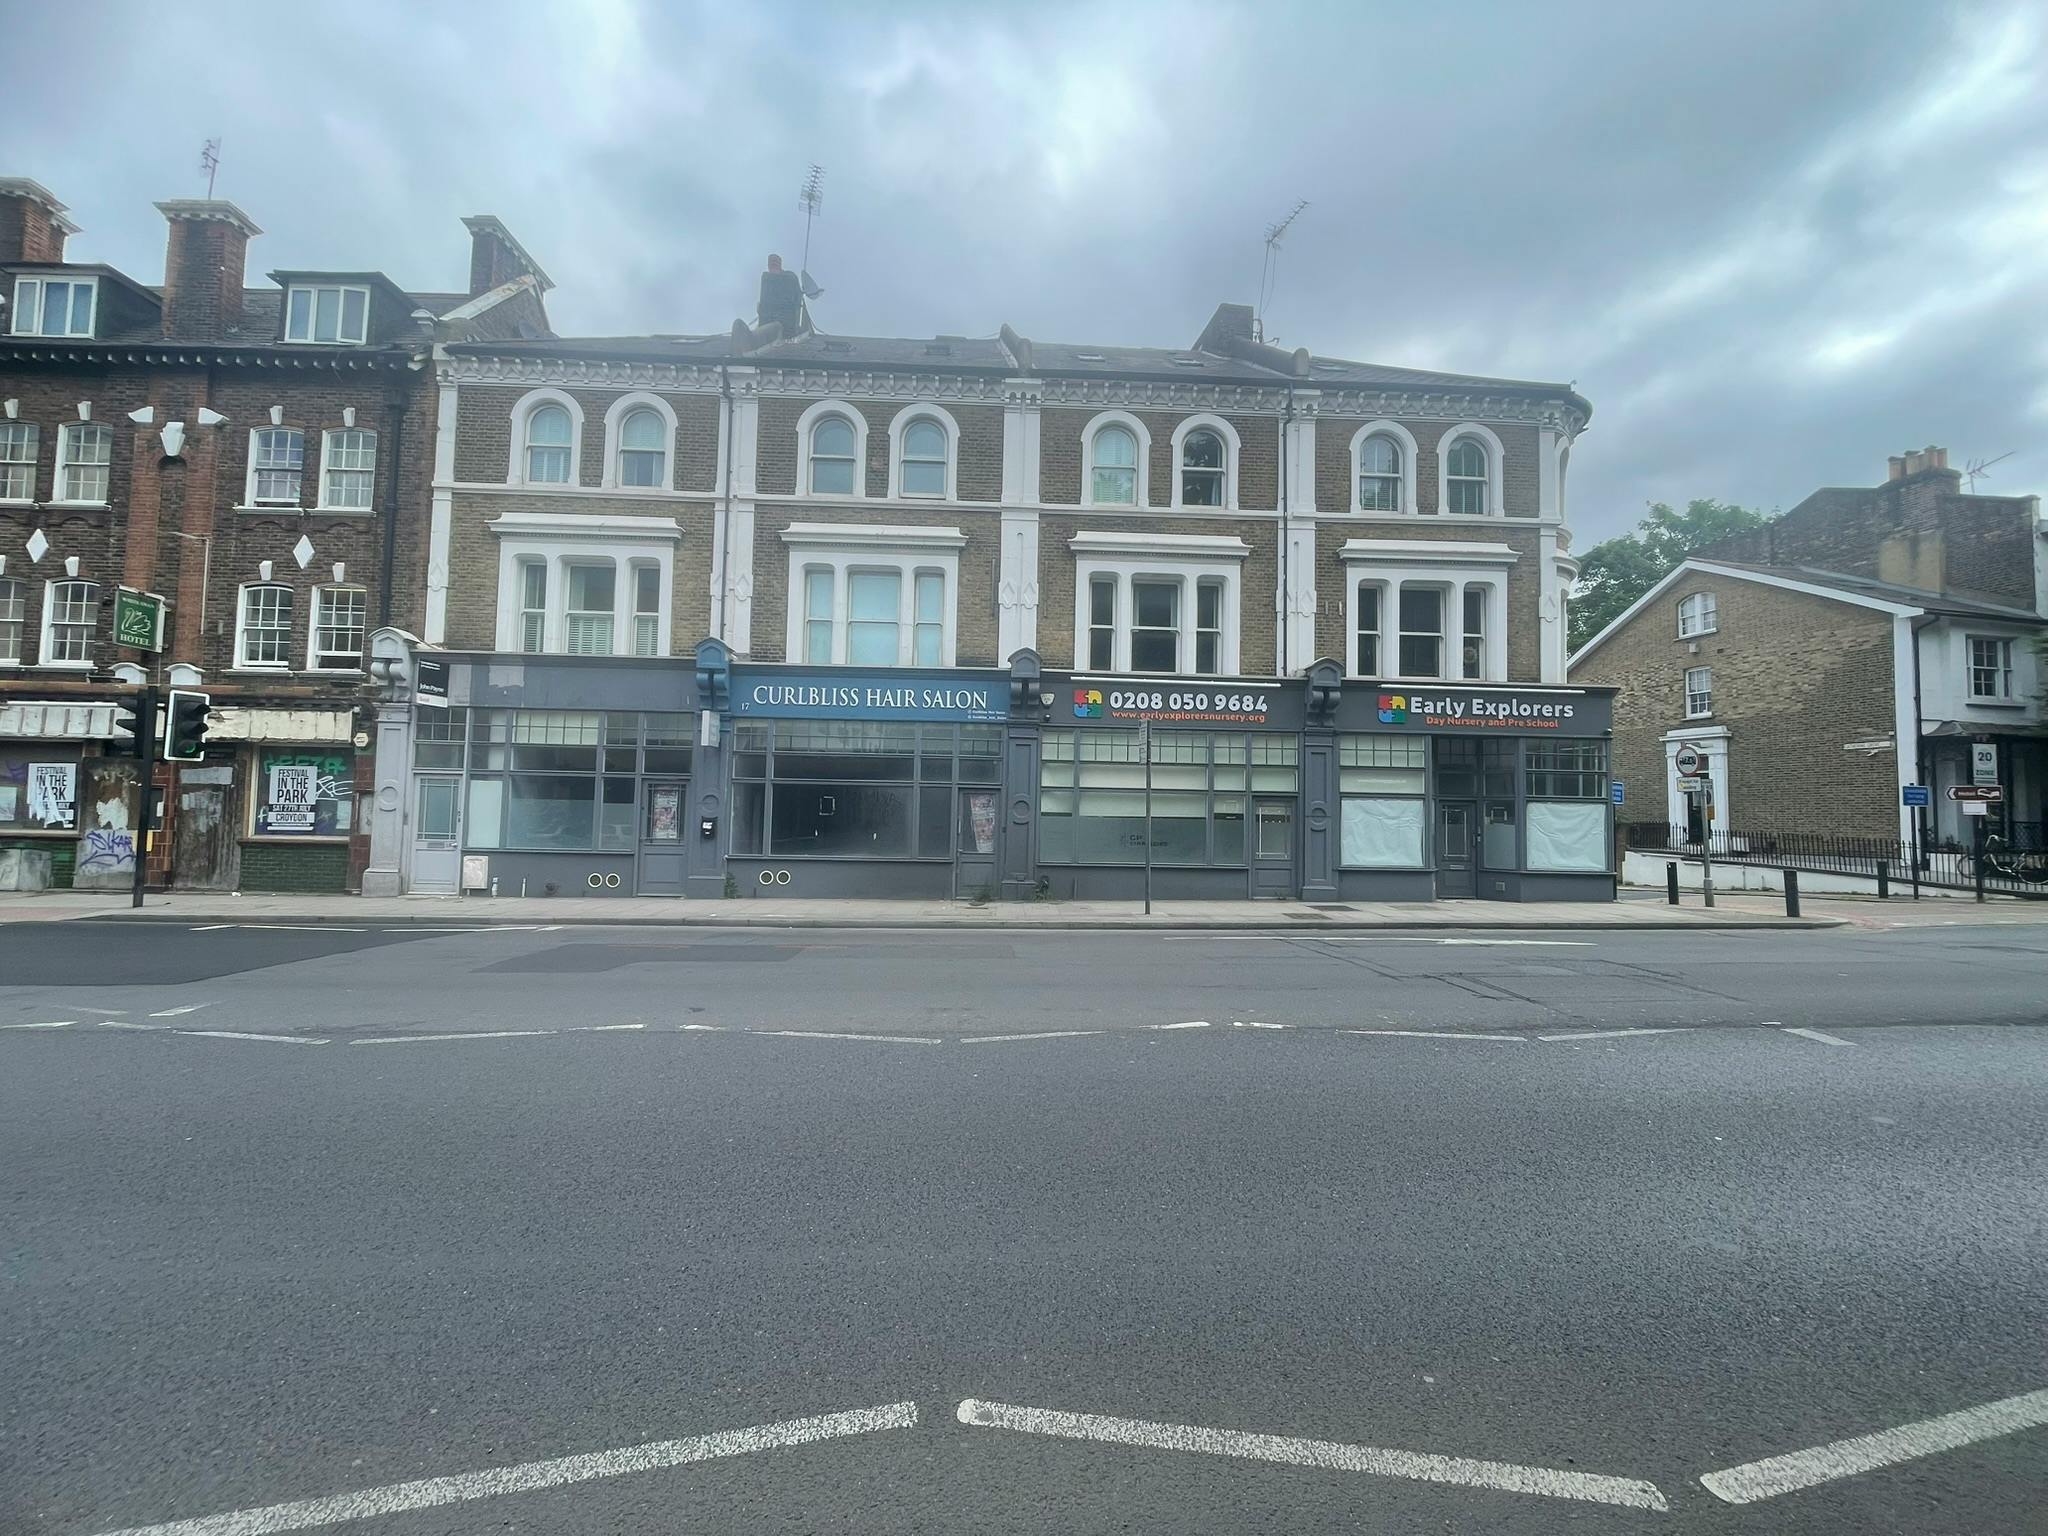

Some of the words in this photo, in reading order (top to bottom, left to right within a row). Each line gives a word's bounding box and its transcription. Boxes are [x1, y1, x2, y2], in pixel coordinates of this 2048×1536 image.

[120, 633, 151, 646] HOTEL
[753, 685, 859, 706] CURLBLISS
[865, 688, 918, 708] HAIR
[921, 689, 988, 709] SALON
[1109, 691, 1163, 710] 0208
[1168, 693, 1209, 711] 050
[1214, 694, 1268, 712] 9684
[741, 702, 750, 711] 17
[1410, 696, 1466, 718] Early
[1471, 698, 1574, 719] Explorers
[1112, 711, 1265, 723] www.earlyexplorersnursery.org
[1426, 716, 1446, 726] Day
[1447, 717, 1486, 728] Nursery
[1488, 718, 1507, 727] and
[1508, 719, 1525, 728] Pre
[1526, 720, 1558, 728] School
[1978, 752, 1992, 761] 20
[36, 766, 67, 775] FESTIVAL
[278, 768, 309, 778] FESTIVAL
[49, 774, 67, 787] THE
[277, 777, 288, 789] IN
[290, 777, 310, 789] THE
[276, 789, 309, 803] PARK
[275, 813, 308, 822] CROYDON
